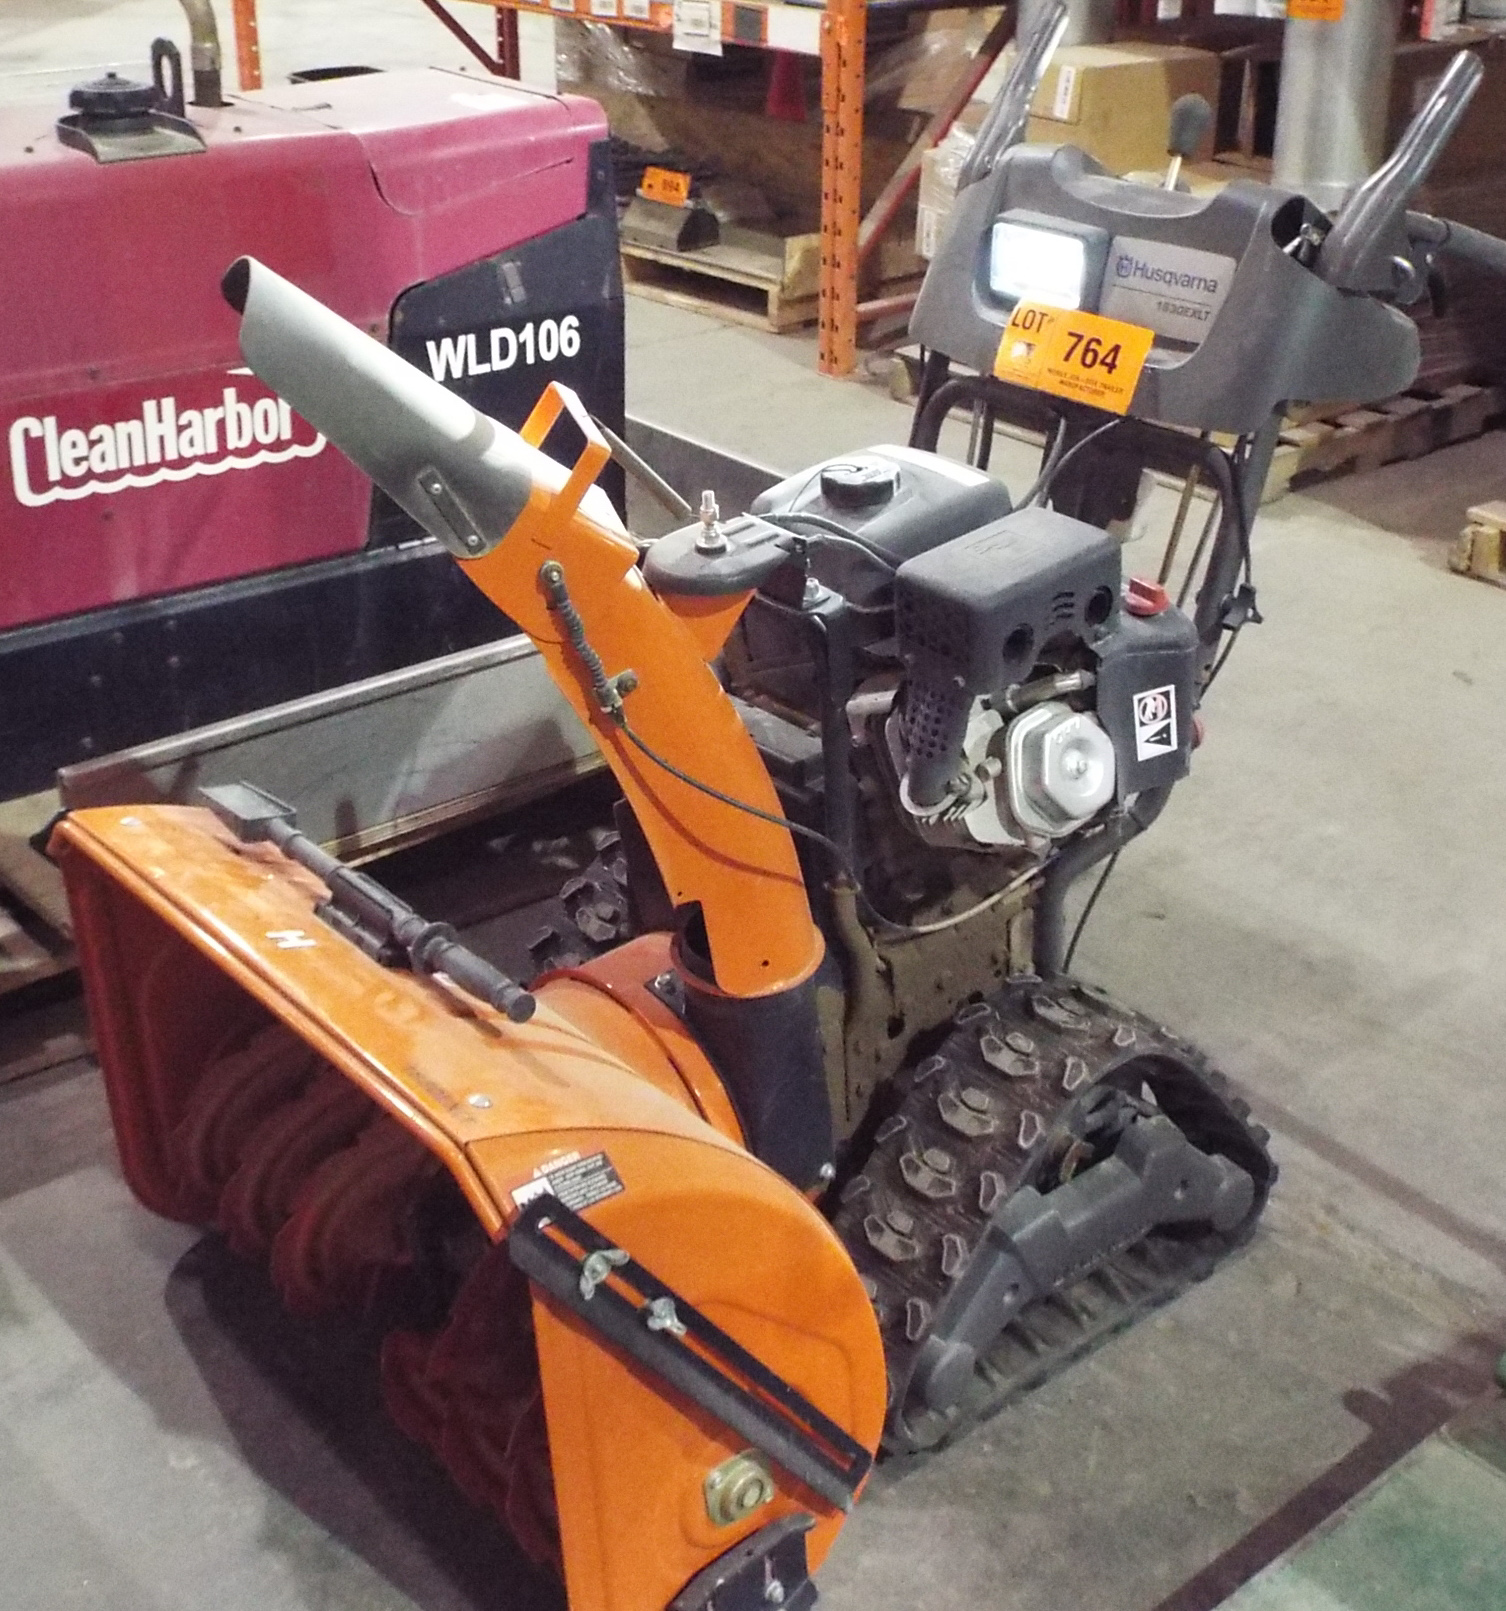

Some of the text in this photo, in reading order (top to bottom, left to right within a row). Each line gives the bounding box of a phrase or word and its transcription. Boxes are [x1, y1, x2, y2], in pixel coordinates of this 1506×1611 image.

[1133, 260, 1218, 293] Husqvarna
[1011, 308, 1049, 333] LOT
[425, 315, 581, 382] WLD106
[1063, 331, 1122, 374] 764
[9, 387, 326, 507] CleanHarbor
